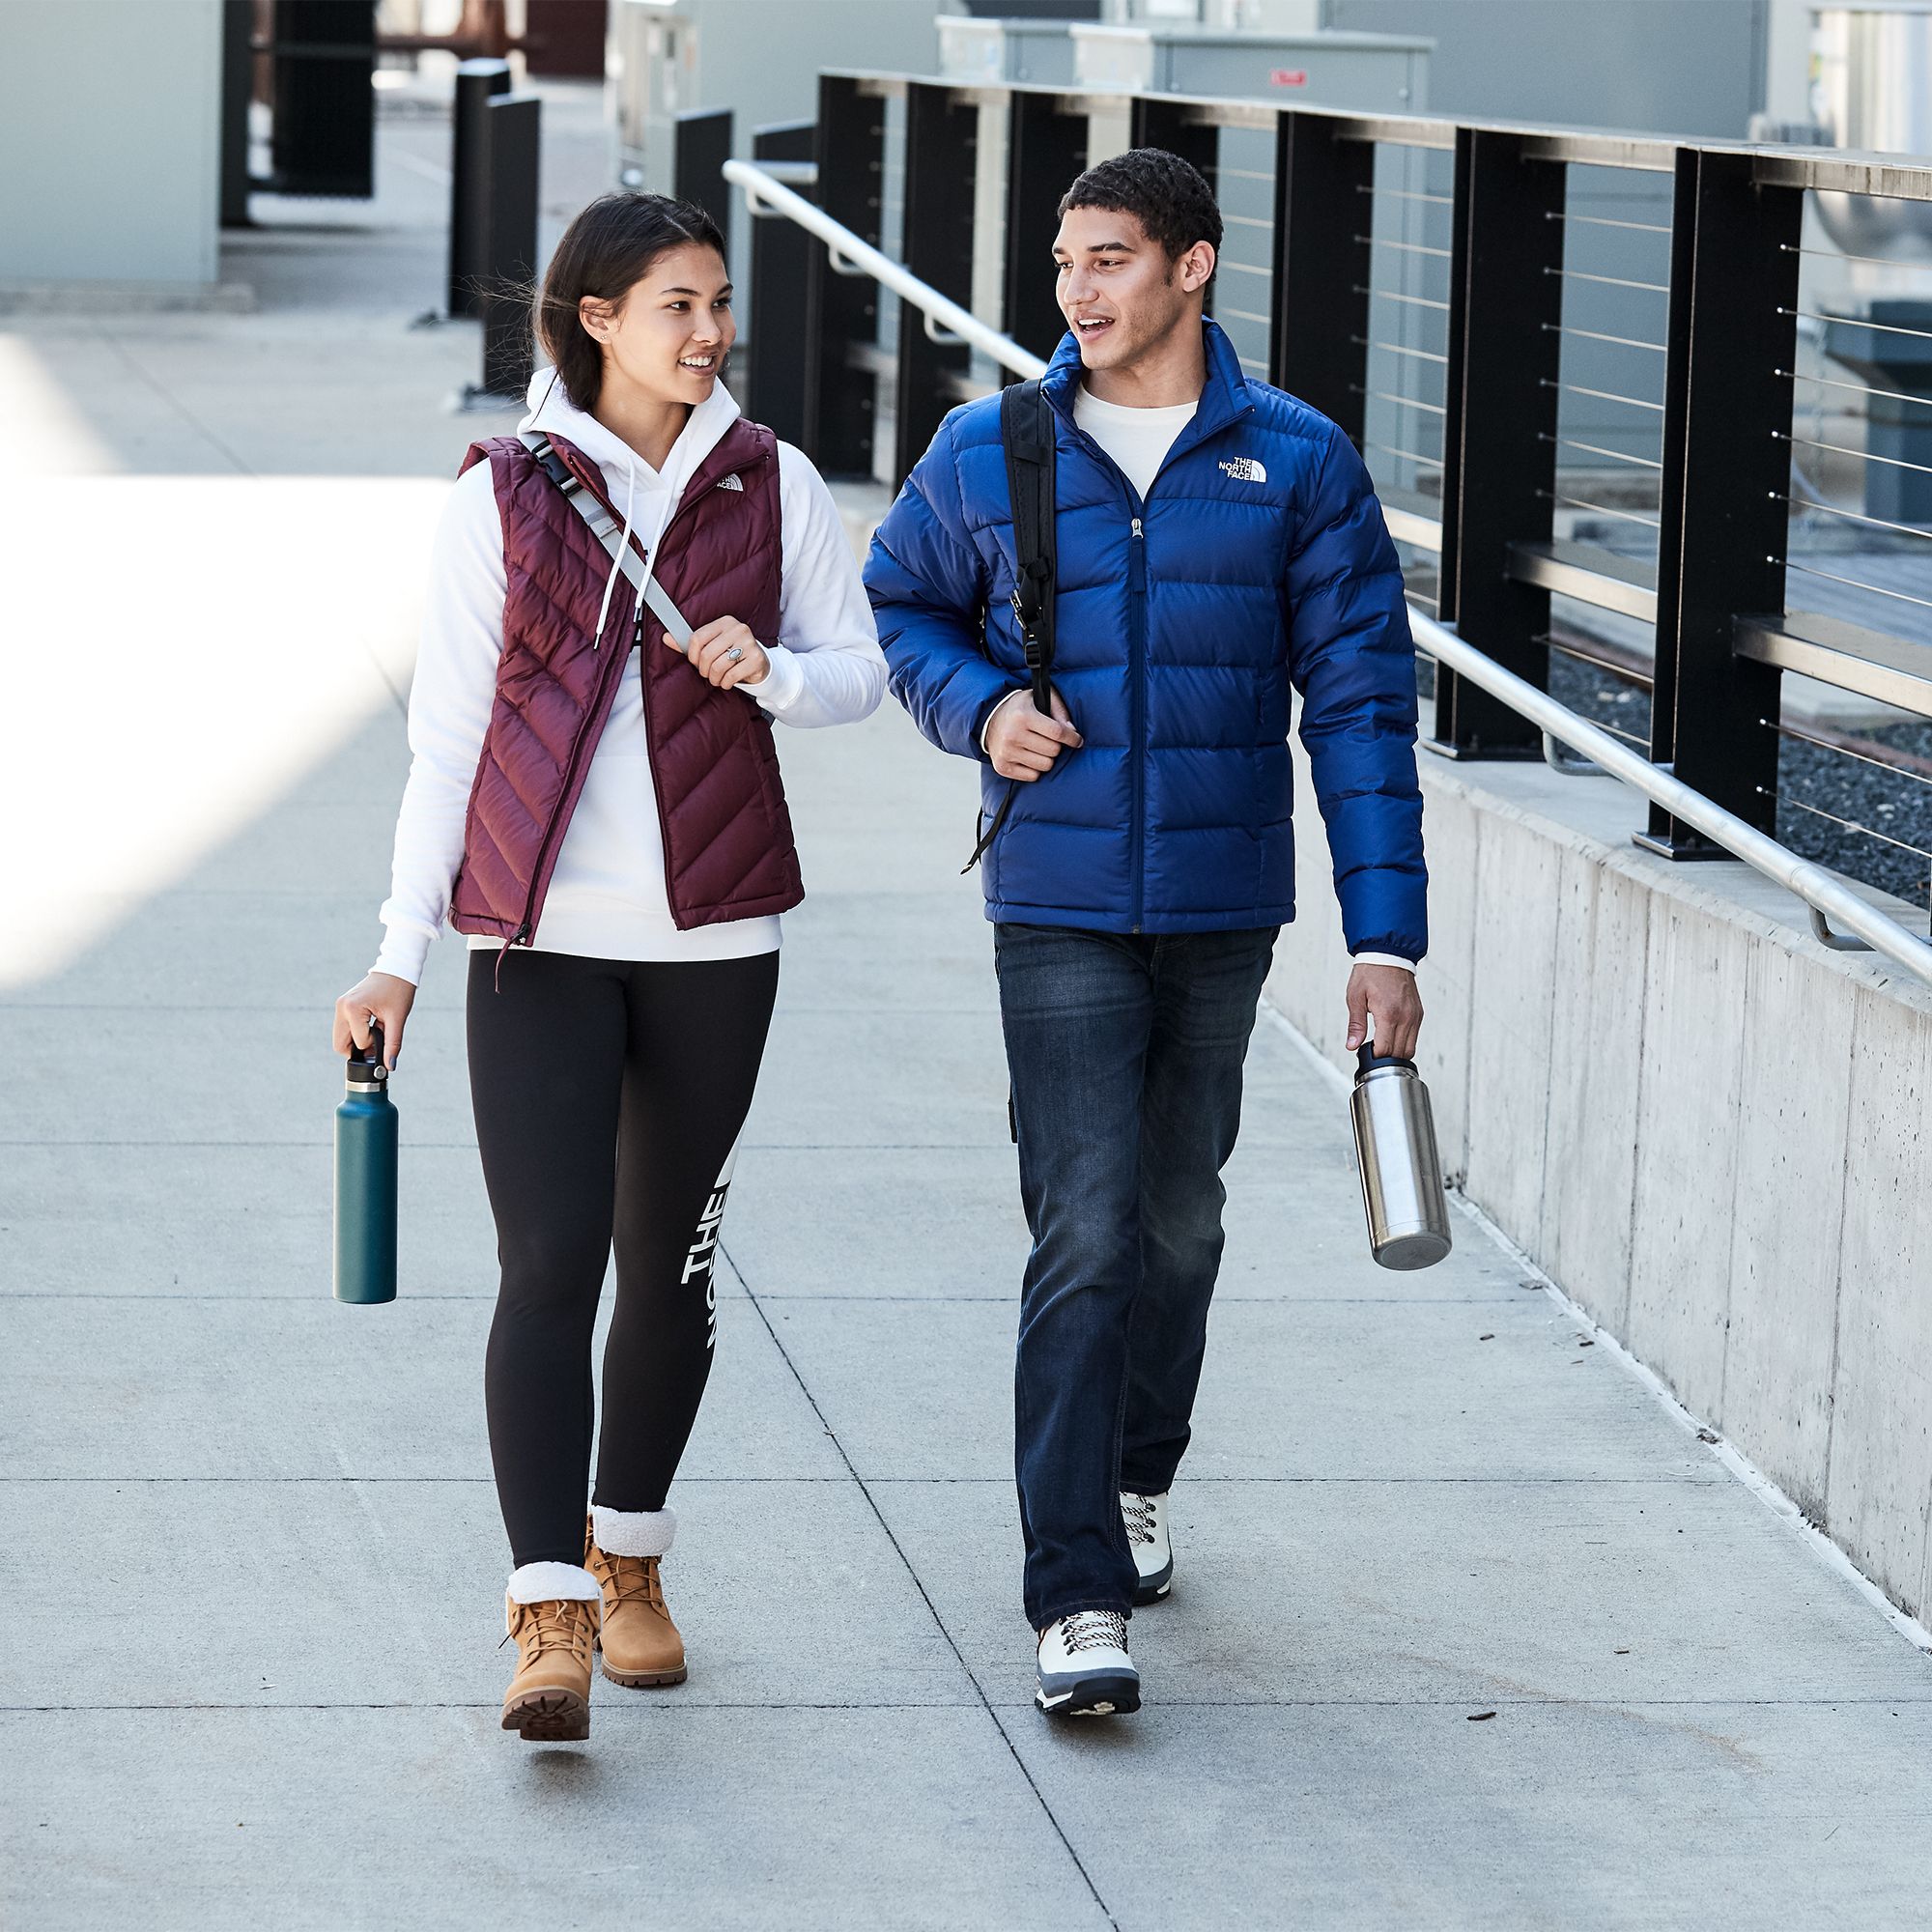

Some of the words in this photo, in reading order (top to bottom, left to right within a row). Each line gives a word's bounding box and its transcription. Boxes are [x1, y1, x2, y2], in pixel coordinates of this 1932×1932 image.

[1235, 457, 1252, 466] THE
[1219, 462, 1251, 473] NORTH
[1228, 470, 1250, 480] FACE
[680, 1192, 724, 1285] THE
